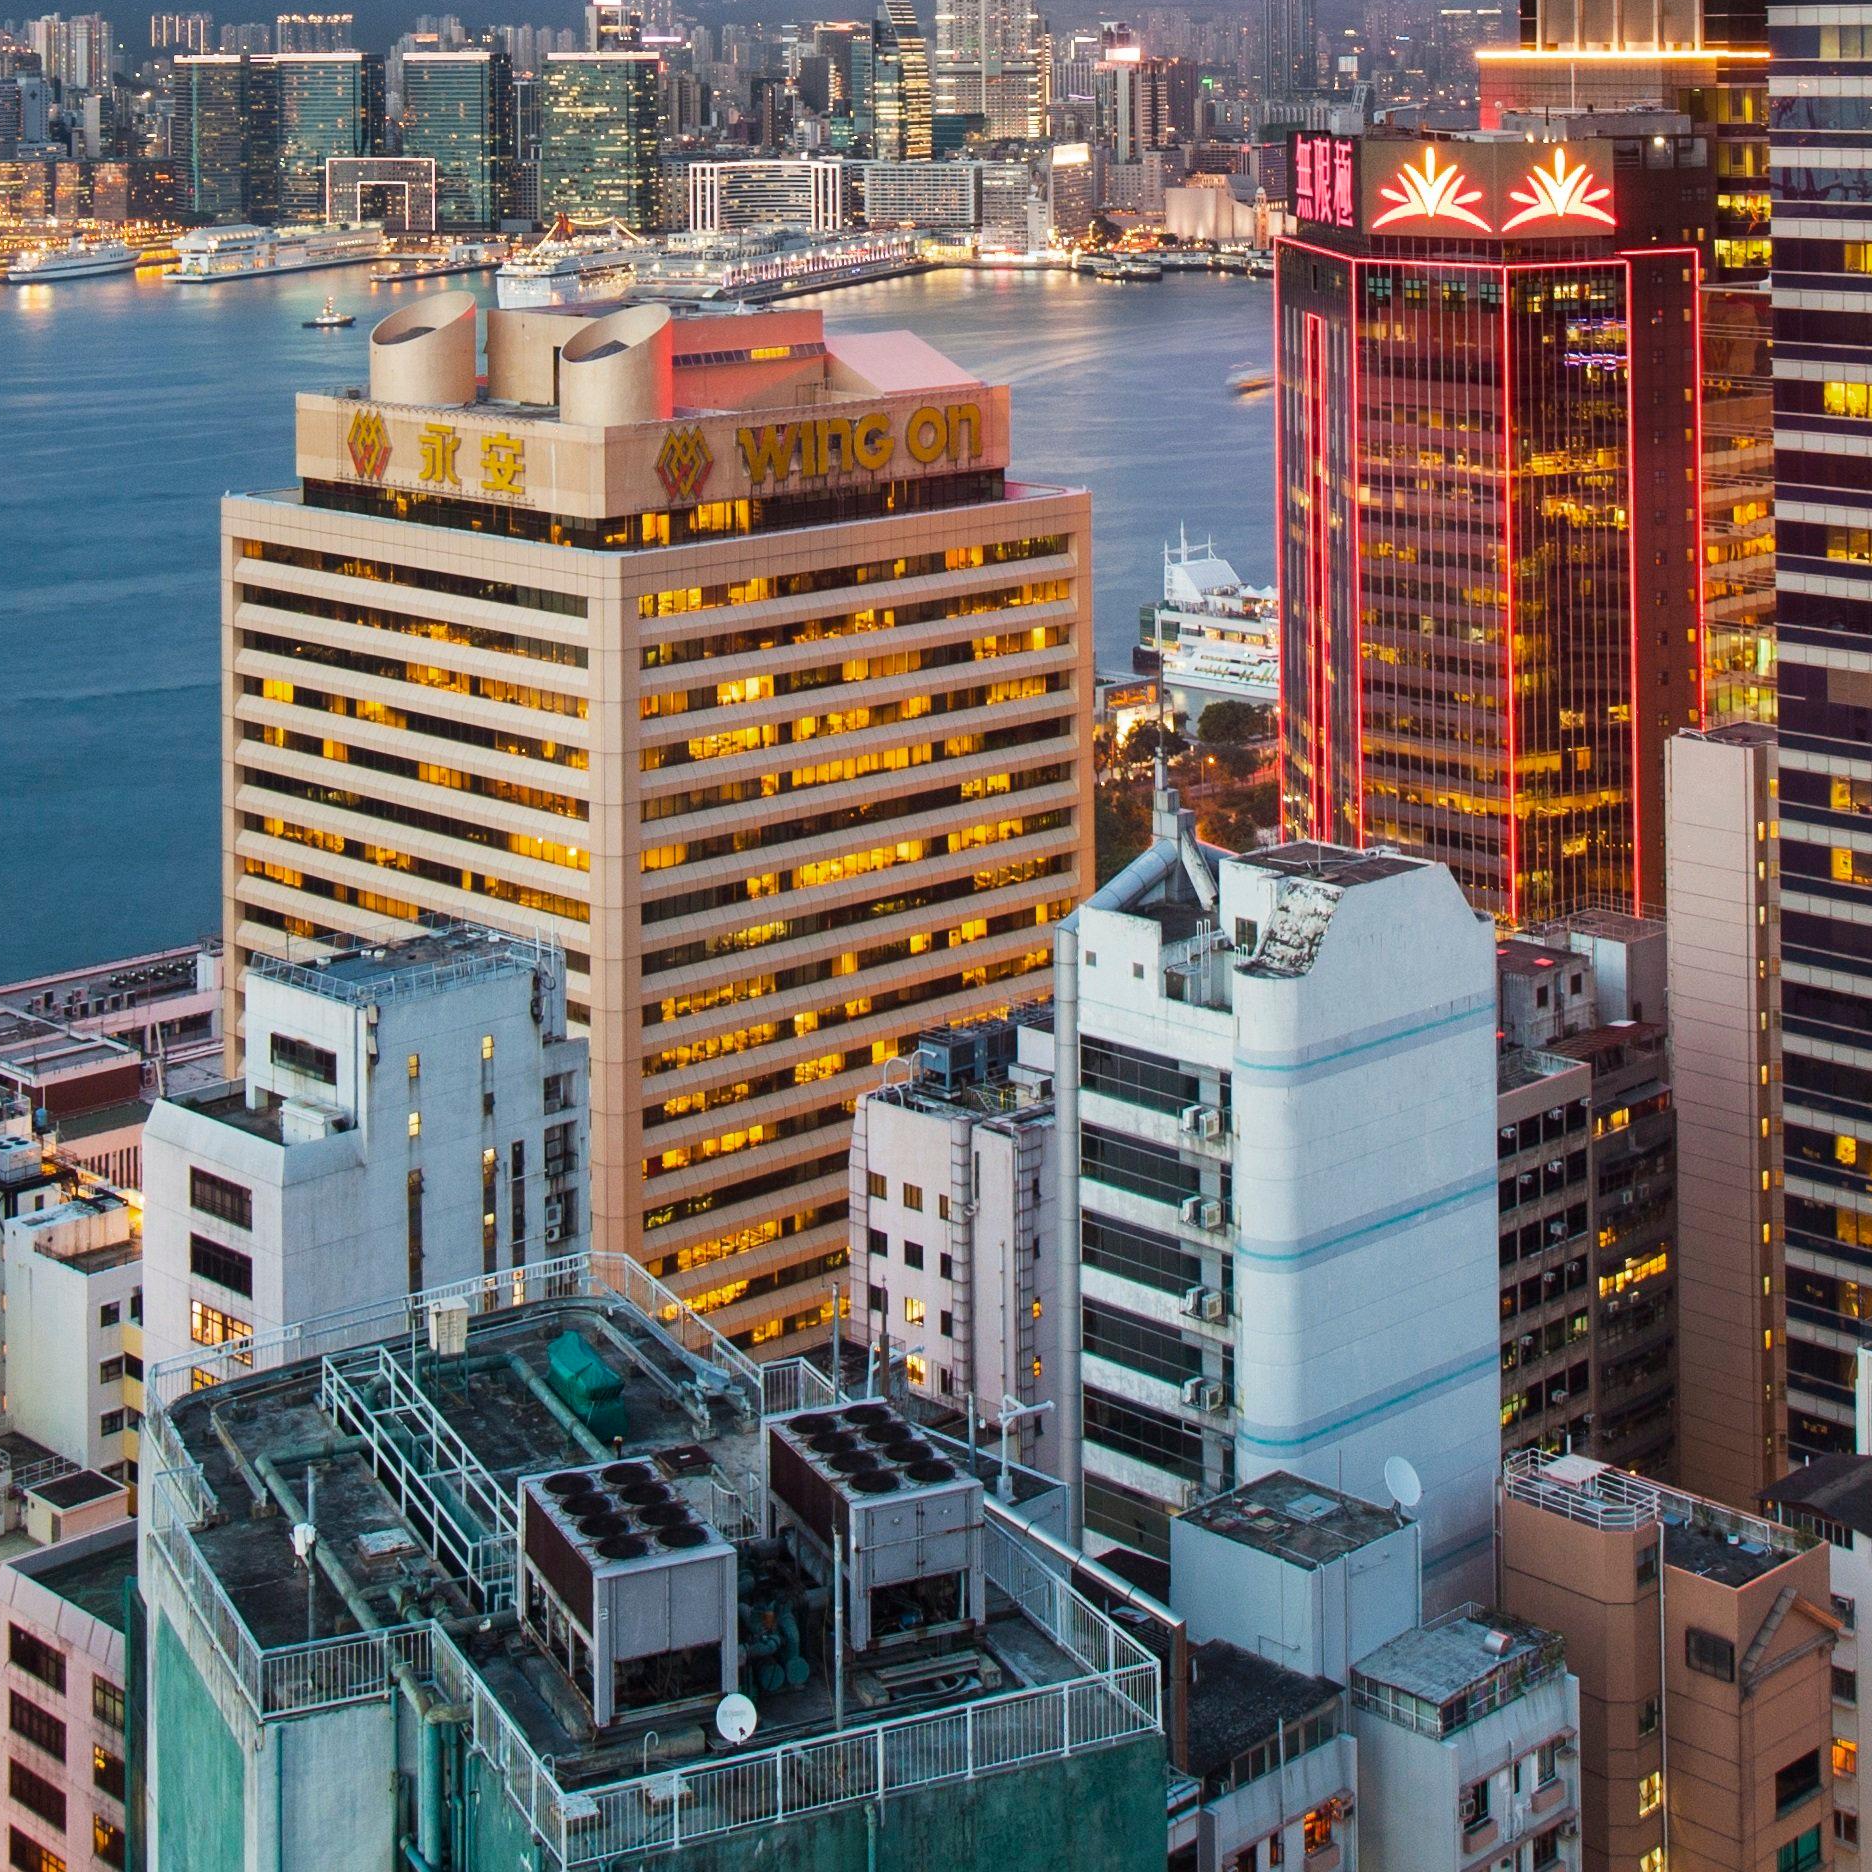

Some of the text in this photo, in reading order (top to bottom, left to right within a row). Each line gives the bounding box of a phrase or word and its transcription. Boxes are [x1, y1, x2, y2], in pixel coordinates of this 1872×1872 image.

[1296, 133, 1354, 227] 無限極
[418, 422, 526, 495] 永安
